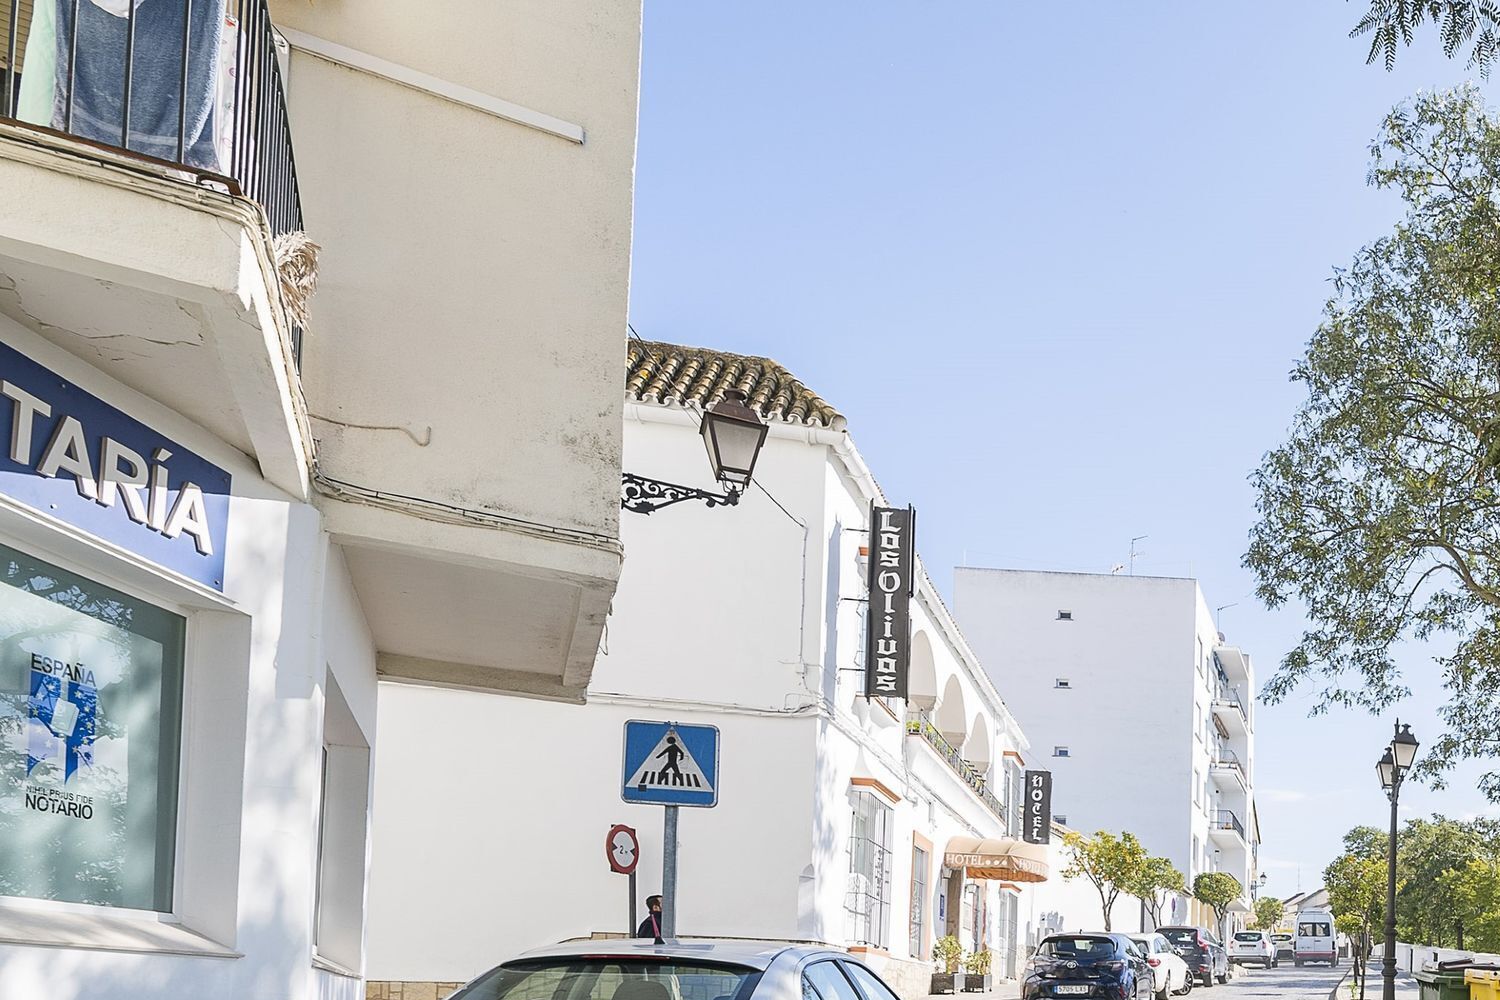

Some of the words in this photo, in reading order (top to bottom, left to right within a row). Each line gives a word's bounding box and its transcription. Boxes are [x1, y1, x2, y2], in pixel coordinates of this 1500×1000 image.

[31, 652, 96, 687] ESPAÑA
[25, 793, 93, 820] NOTARIO
[945, 853, 985, 866] HOTEL
